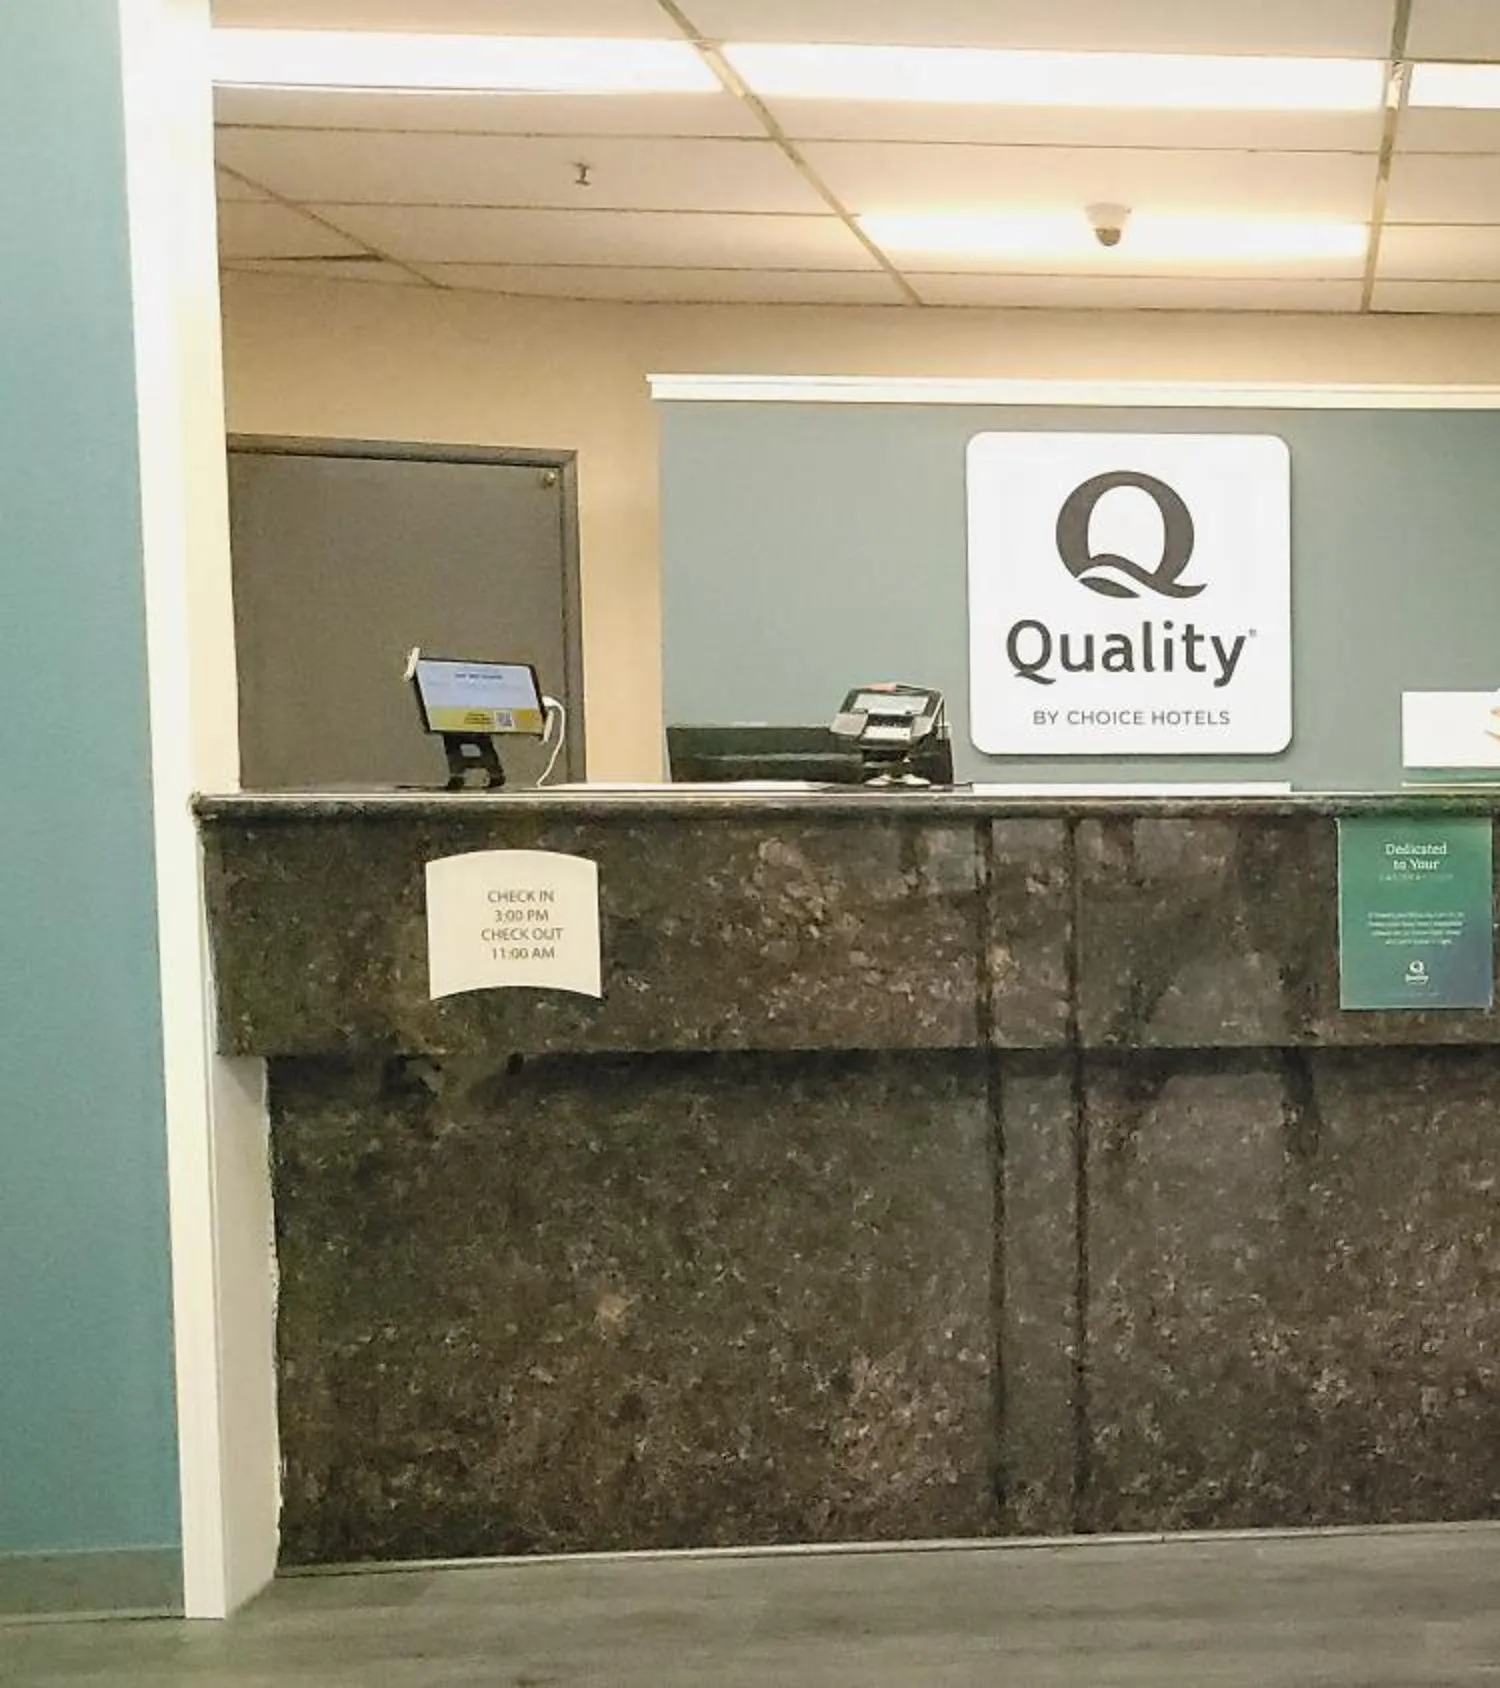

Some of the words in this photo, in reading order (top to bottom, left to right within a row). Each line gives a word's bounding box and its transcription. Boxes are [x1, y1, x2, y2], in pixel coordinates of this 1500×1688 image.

[1055, 469, 1207, 599] Q
[1032, 710, 1059, 725] BY
[1067, 710, 1144, 725] CHOICE
[1151, 710, 1231, 725] HOTELS
[1385, 842, 1447, 855] Dedicated
[1393, 859, 1407, 870] to
[1409, 858, 1440, 870] Your
[487, 889, 536, 904] CHECK
[539, 889, 555, 902] IN
[494, 908, 523, 923] 3:00
[527, 908, 550, 921] PM
[481, 927, 530, 941] CHECK
[531, 927, 564, 941] OUT
[492, 946, 529, 961] 11:00
[531, 946, 555, 960] AM
